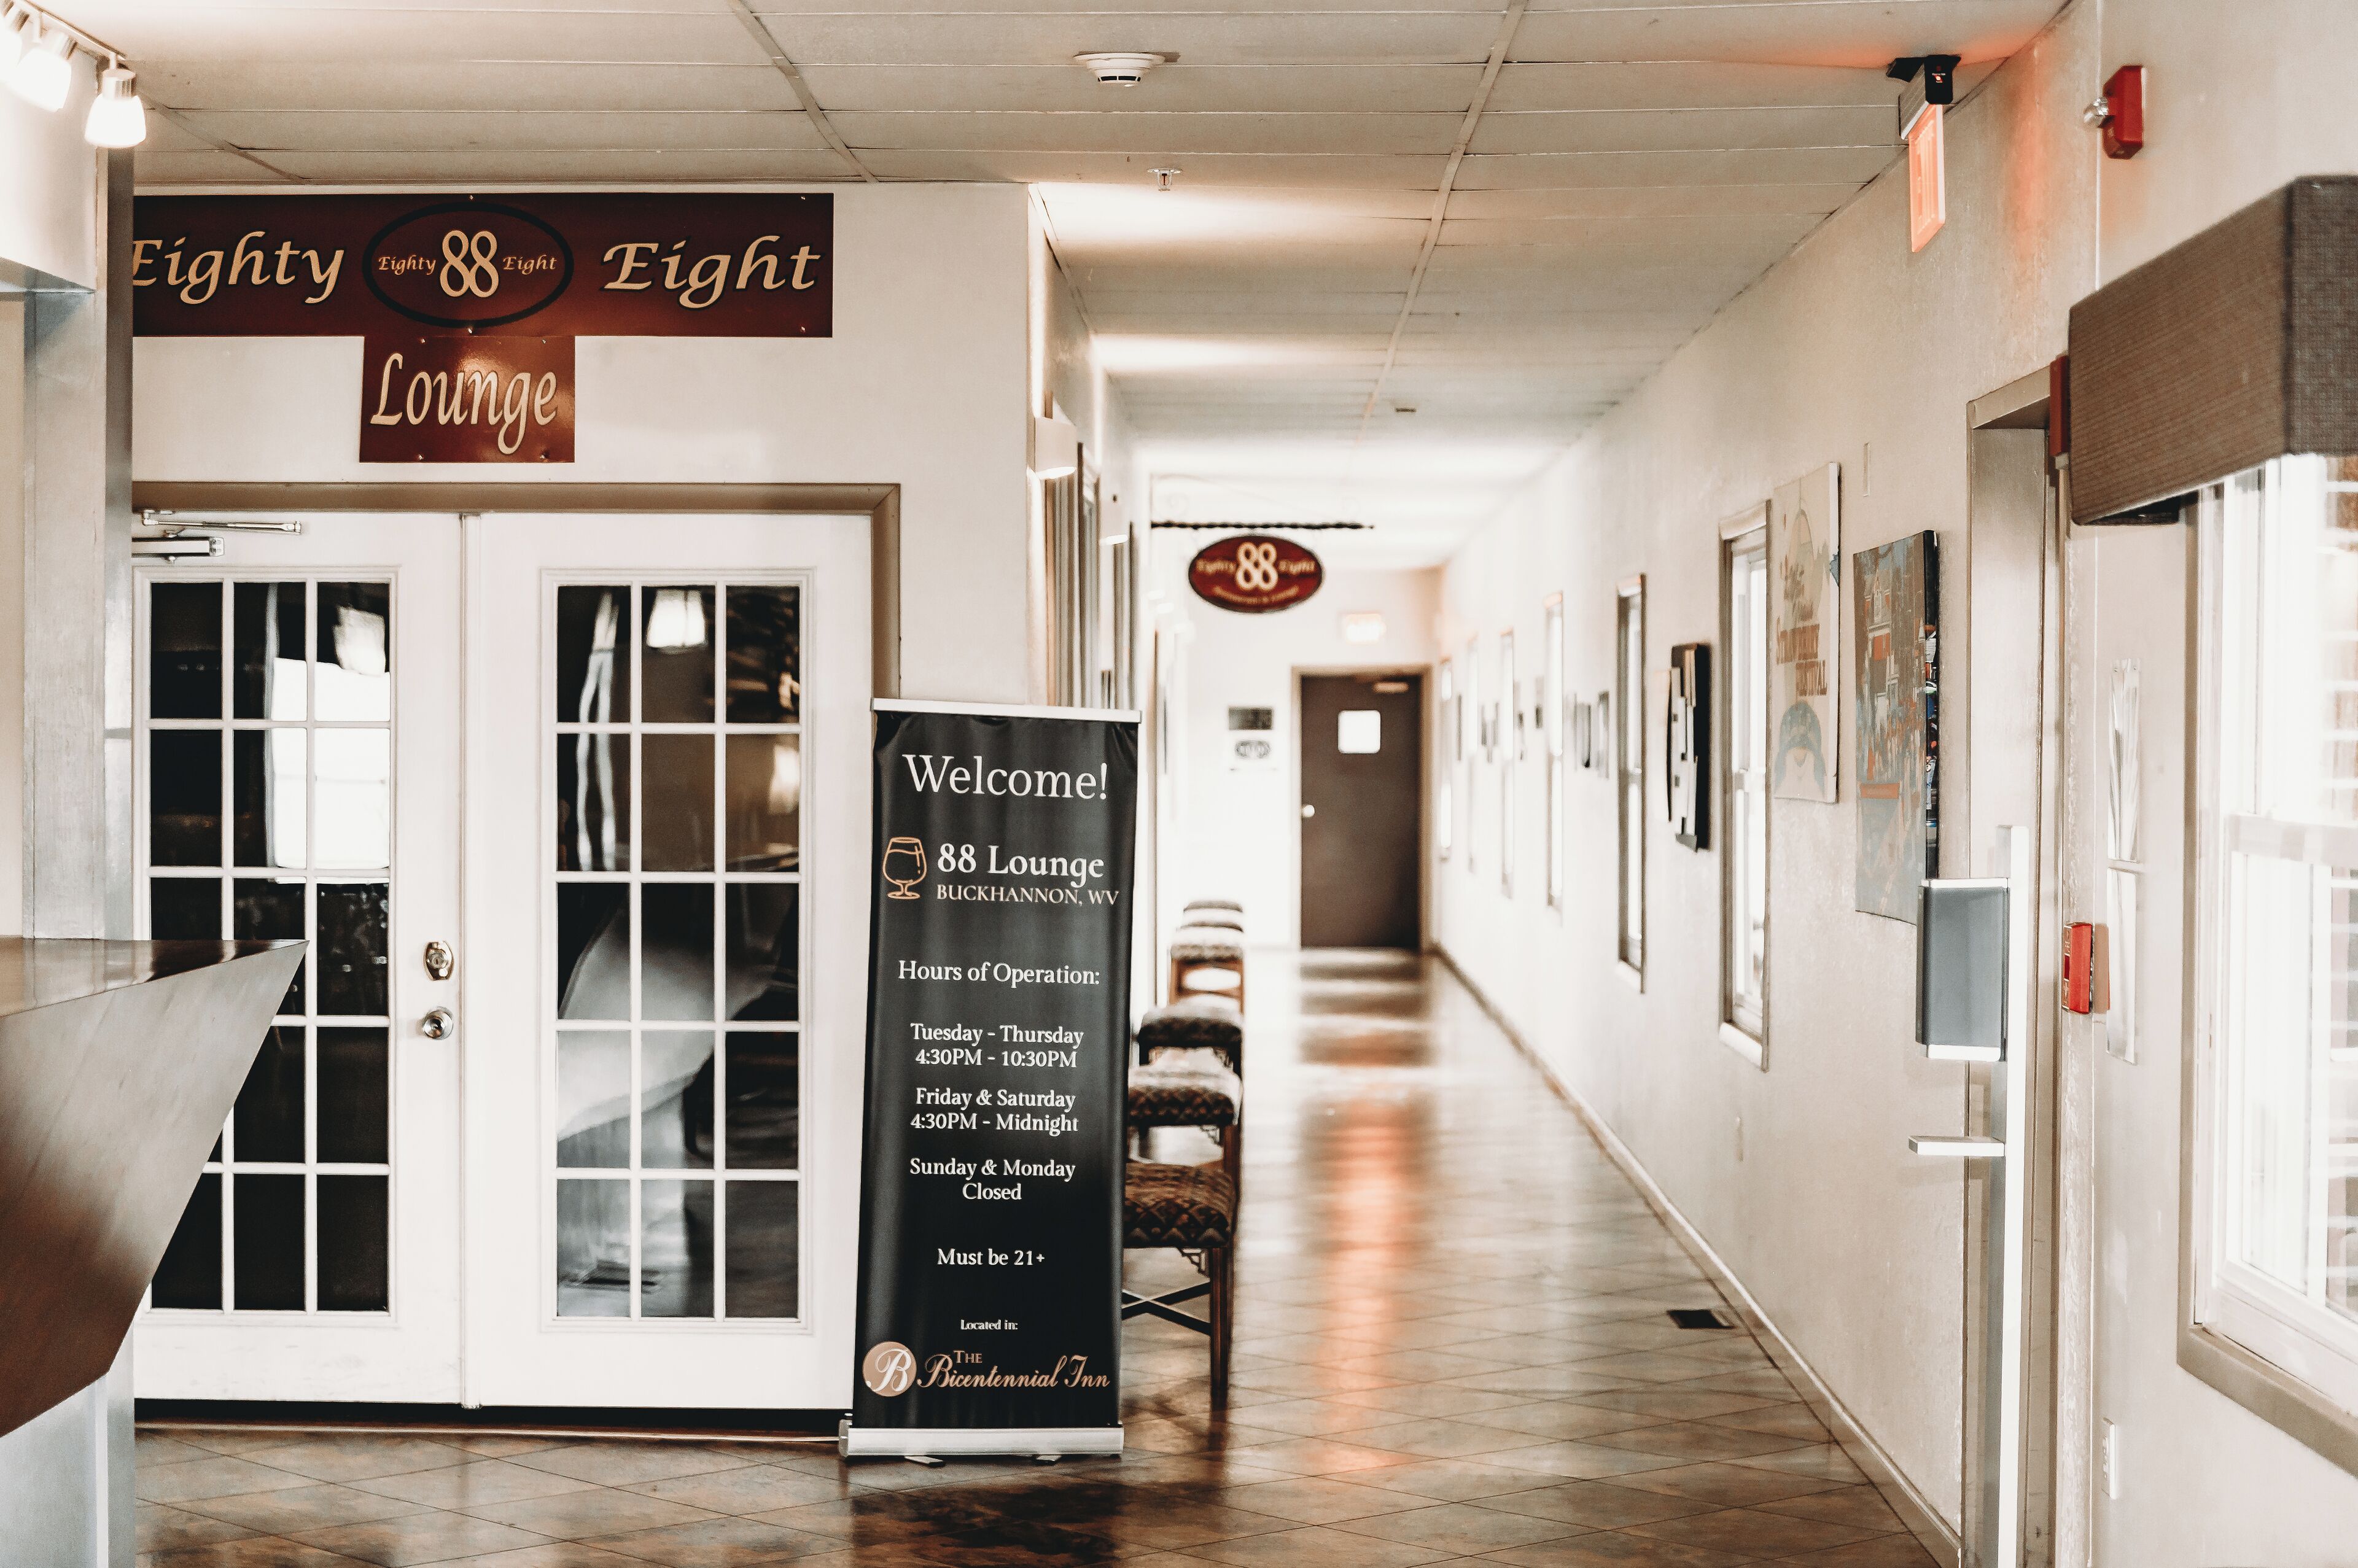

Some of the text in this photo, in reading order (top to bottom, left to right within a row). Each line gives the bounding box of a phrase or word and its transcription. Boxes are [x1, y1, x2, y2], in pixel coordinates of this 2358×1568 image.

[133, 231, 344, 305] Eighty
[378, 230, 557, 298] Eighty 88 Eight
[604, 235, 822, 309] Eight
[370, 352, 556, 456] Lounge
[1235, 541, 1278, 591] 88
[901, 753, 1108, 801] Welcome!
[936, 842, 1105, 889] 88 Lounge
[936, 883, 1119, 907] BUCKHANNON, WV
[898, 960, 1101, 990] Hours of Operation:
[909, 1022, 984, 1047] Tuesday
[999, 1024, 1085, 1050] Thursday
[915, 1048, 983, 1066] 4:30PM
[1000, 1050, 1079, 1069] 10:30PM
[916, 1087, 1077, 1113] Friday & Saturday
[910, 1112, 978, 1130] 4:30PM
[995, 1112, 1080, 1137] Midnight
[909, 1157, 1076, 1182] Sunday & Monday
[962, 1182, 1022, 1201] Closed
[937, 1248, 1045, 1266] Must be 21+
[960, 1319, 1019, 1331] Located in:
[916, 1353, 1111, 1389] Bicentennial Inn
[953, 1350, 982, 1364] THE
